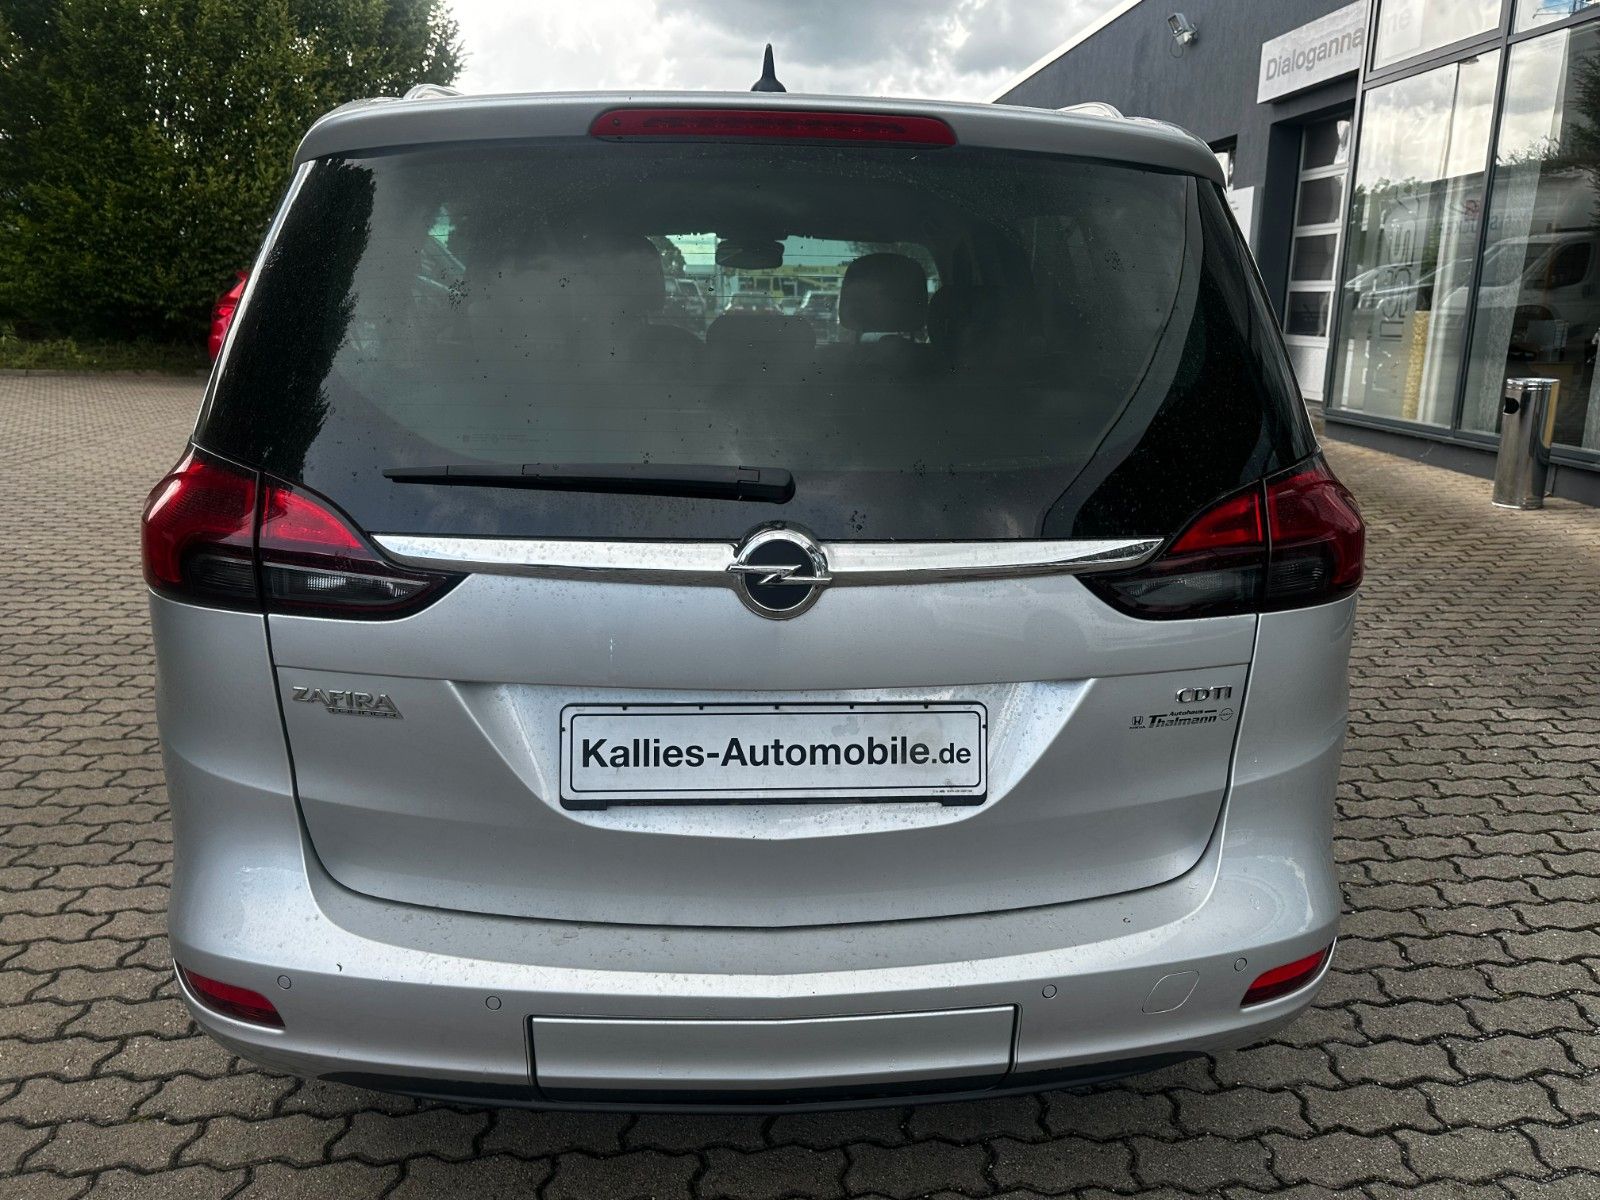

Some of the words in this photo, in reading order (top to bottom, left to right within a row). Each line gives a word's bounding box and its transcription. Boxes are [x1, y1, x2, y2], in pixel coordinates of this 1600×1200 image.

[292, 686, 402, 715] ZAFIRA
[1175, 685, 1232, 703] CDTI
[1149, 714, 1217, 729] Thalmann
[1168, 709, 1204, 717] Autohaus
[581, 735, 972, 768] Kallies-Automobile.de
